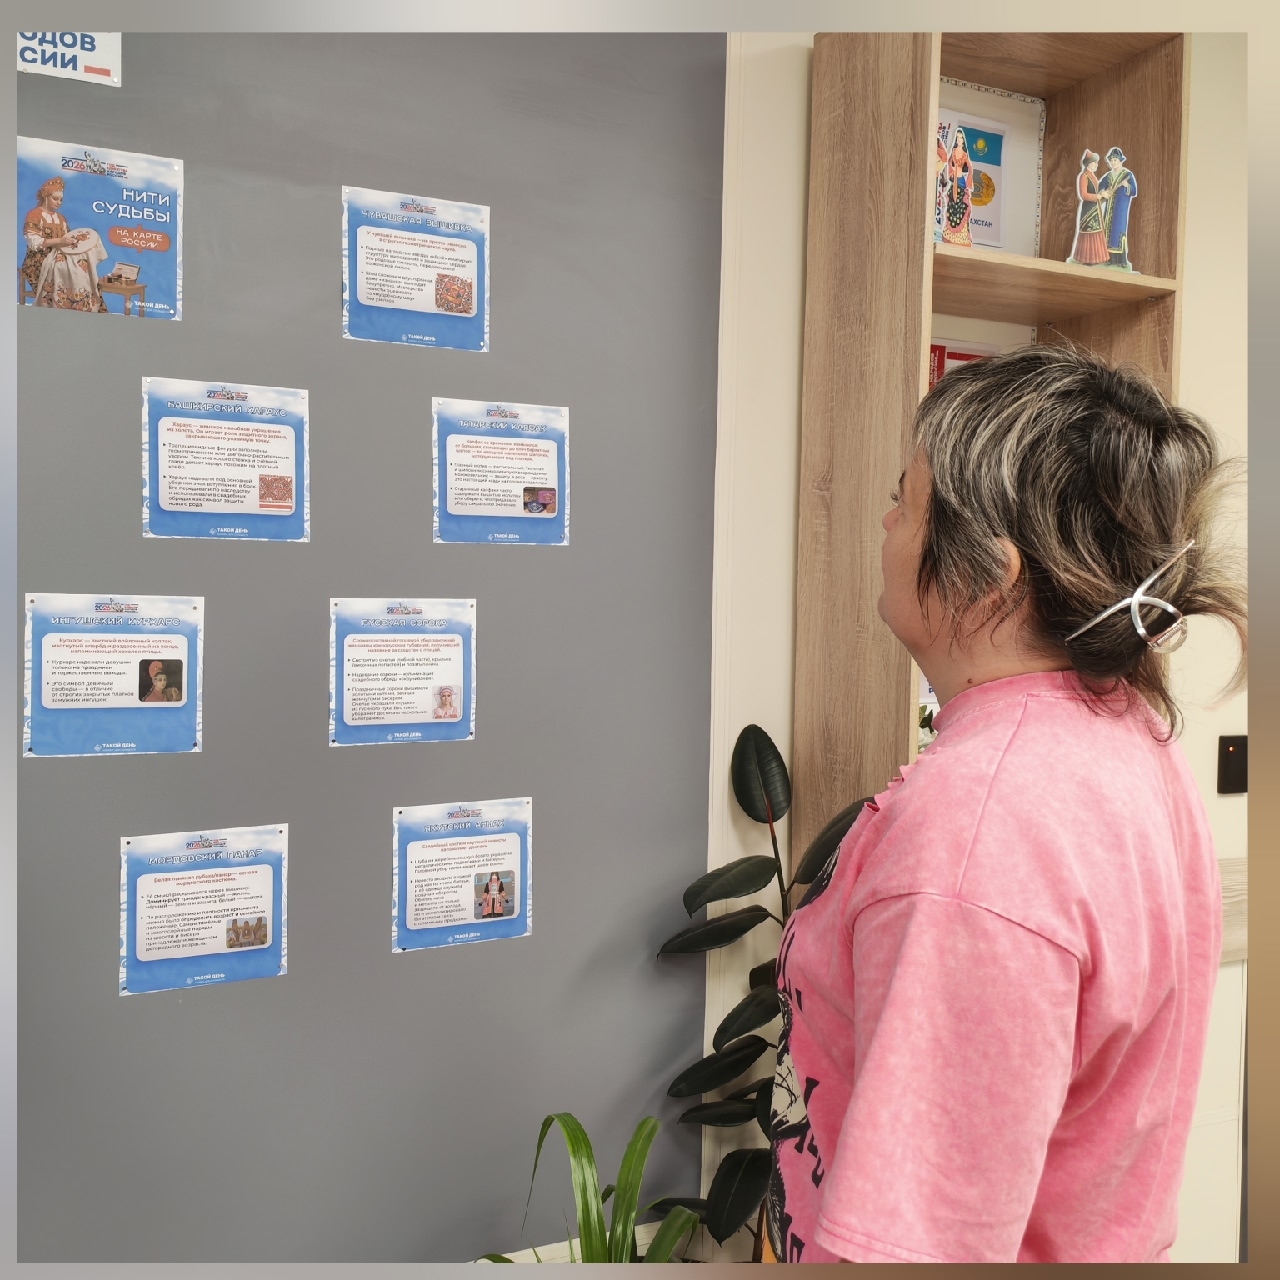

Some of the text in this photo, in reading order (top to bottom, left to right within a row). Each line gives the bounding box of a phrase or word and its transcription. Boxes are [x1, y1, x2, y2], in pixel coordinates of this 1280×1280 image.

[62, 159, 85, 170] 2026
[122, 188, 170, 207] НИТИ
[92, 202, 170, 223] СУДЬБЫ
[117, 228, 162, 241] НА КАРТЕ
[121, 237, 158, 248] РОССИИ
[167, 401, 242, 413] БАШКИРСКИЙ
[51, 616, 123, 625] ИНГУШСКИЙ
